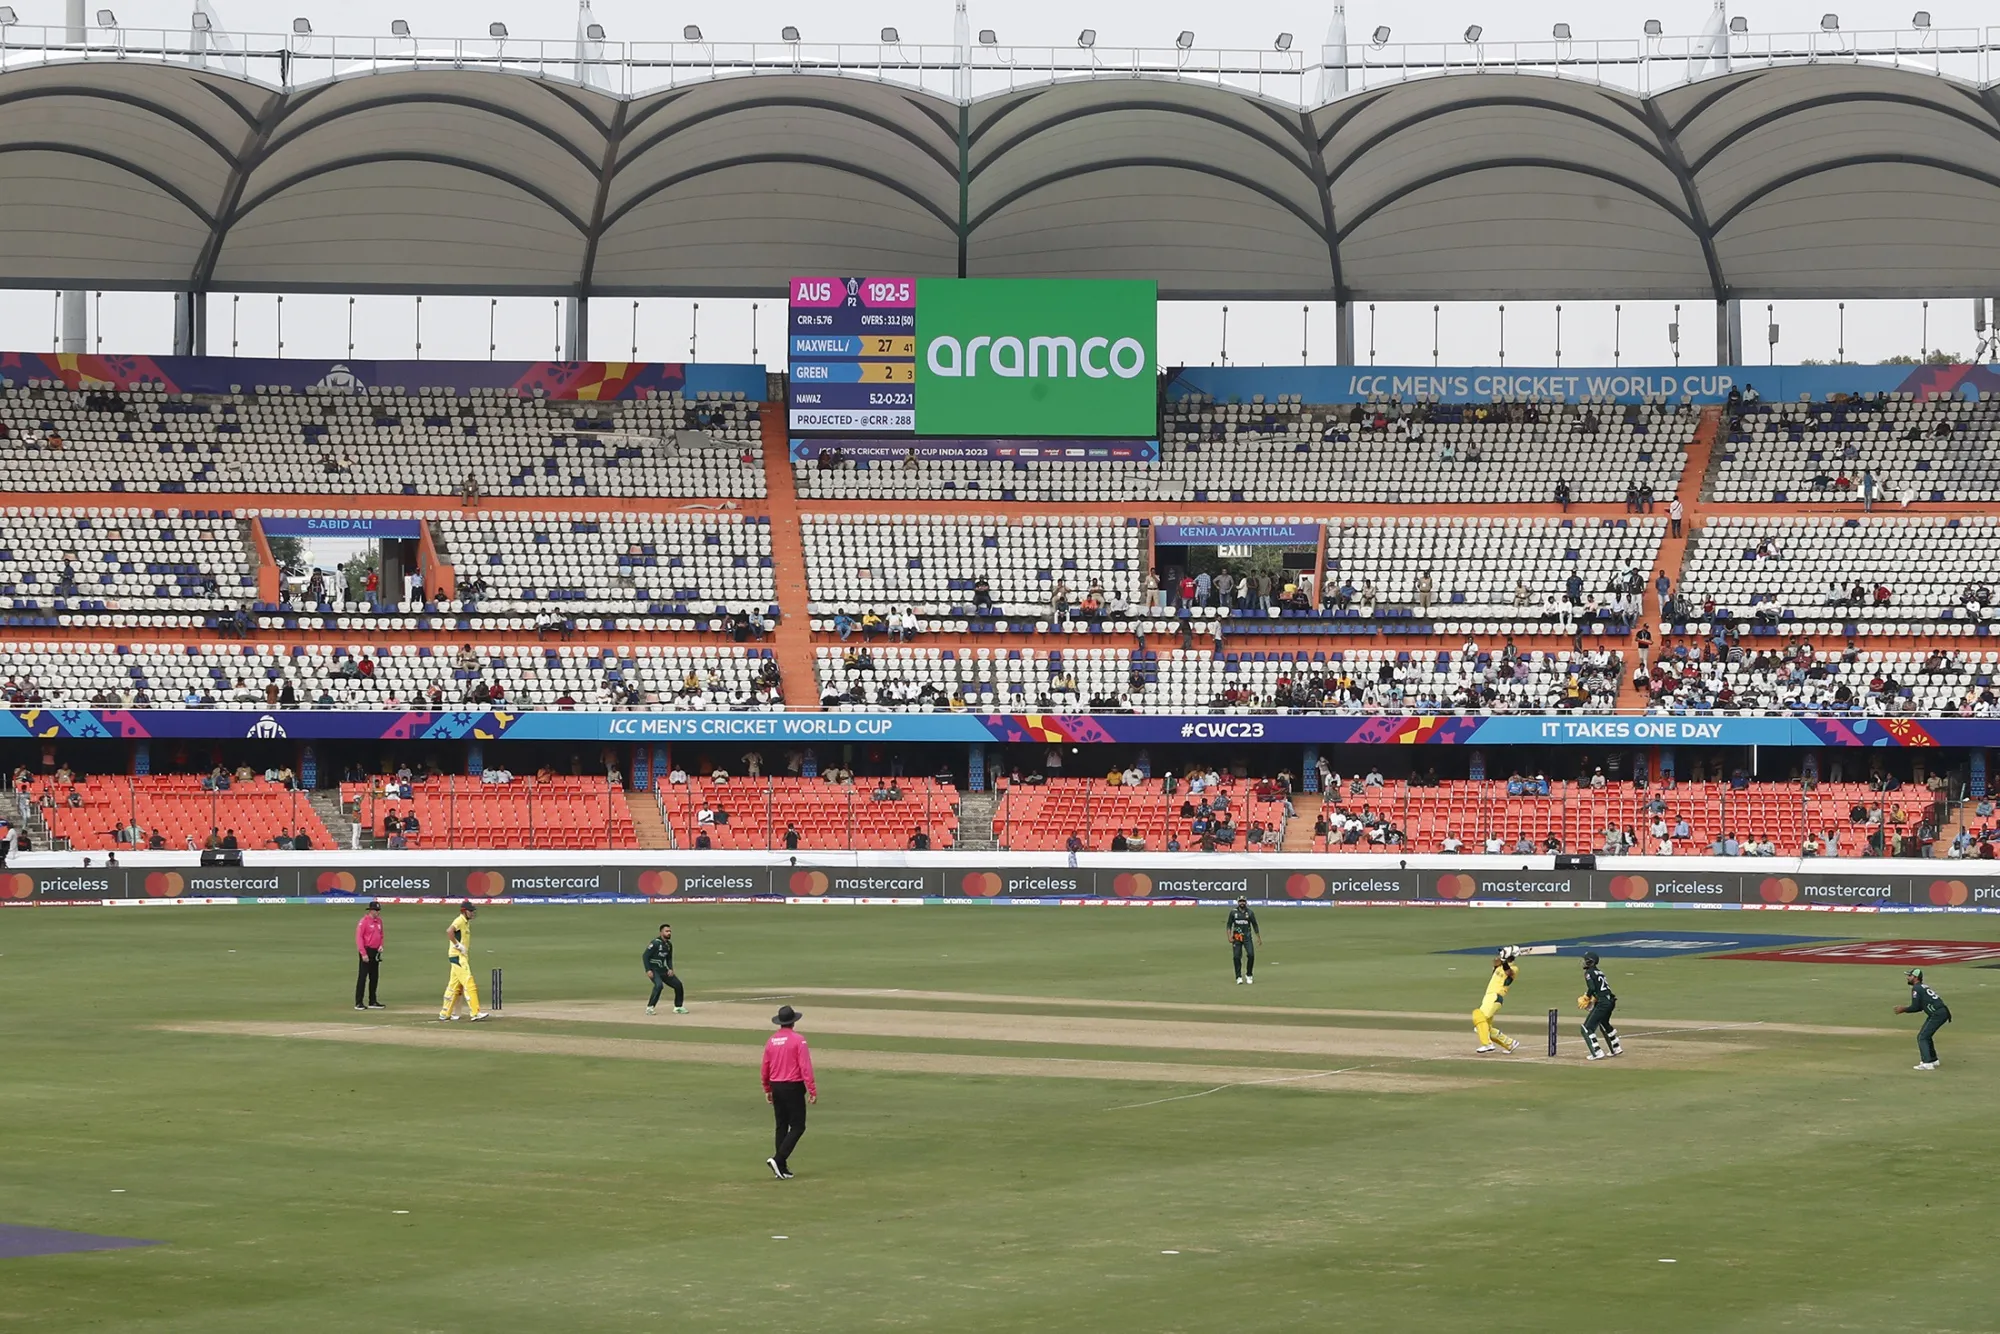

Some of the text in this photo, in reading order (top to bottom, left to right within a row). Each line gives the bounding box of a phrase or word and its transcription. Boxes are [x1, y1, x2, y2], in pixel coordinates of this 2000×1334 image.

[797, 283, 831, 301] AUS
[868, 283, 910, 302] 192-5
[847, 297, 857, 307] P2
[797, 315, 813, 325] CRR
[861, 315, 884, 326] OVERS
[888, 315, 900, 326] 33.2
[901, 315, 914, 327] (50)
[878, 339, 893, 352] 27
[903, 343, 913, 353] 41
[927, 335, 1145, 379] aramco
[796, 366, 828, 379] GREEN
[885, 366, 893, 380] 2
[907, 370, 913, 380] 3
[1348, 375, 1732, 396] ICC MEN'S CRICKET WORLD CUP
[796, 394, 821, 404] NAWAZ
[869, 393, 913, 405] 5.2-0-22-1
[797, 415, 852, 425] PROJECTED
[860, 415, 888, 427] @CRR
[896, 415, 912, 425] 288
[857, 448, 890, 457] CRICKET
[891, 448, 920, 457] WORD
[921, 448, 938, 457] CUP
[939, 448, 964, 456] INDIA
[966, 448, 988, 456] 2023
[308, 519, 372, 530] S.ABID ALI
[1180, 527, 1295, 537] KENIA JAYANTILAL
[609, 719, 892, 734] ICC MEN'S CRICKET WORLD CUP
[1181, 723, 1264, 738] #CWC23
[1542, 722, 1722, 738] IT TAKES ONE DAY
[40, 877, 109, 893] priceless
[190, 876, 279, 890] mastercard
[362, 876, 431, 892] priceless
[511, 875, 600, 889] mastercard
[684, 875, 753, 891] priceless
[835, 876, 924, 890] mastercard
[1008, 876, 1077, 892] priceless
[1158, 878, 1247, 892] mastercard
[1331, 878, 1400, 894] priceless
[1482, 879, 1571, 893] mastercard
[1655, 880, 1724, 896] priceless
[1804, 883, 1891, 898] mastercard
